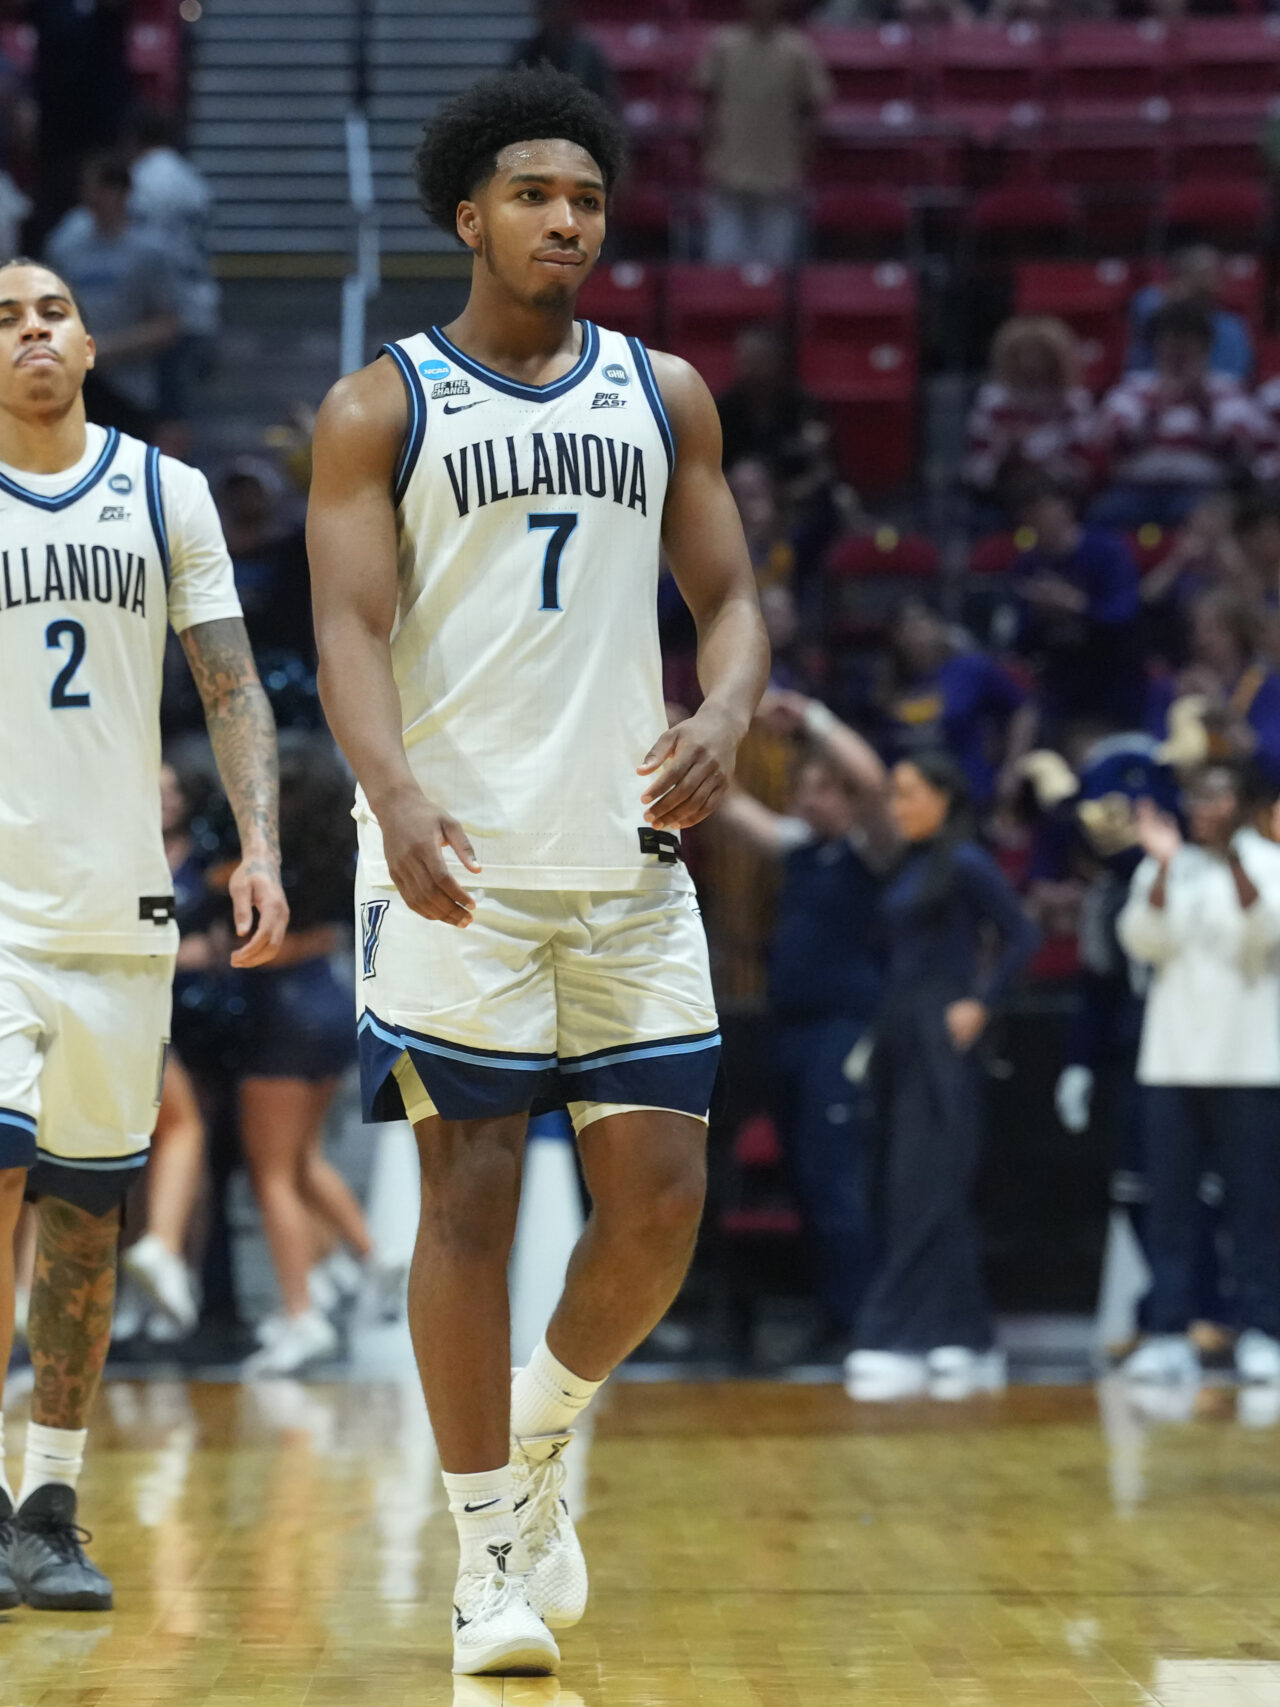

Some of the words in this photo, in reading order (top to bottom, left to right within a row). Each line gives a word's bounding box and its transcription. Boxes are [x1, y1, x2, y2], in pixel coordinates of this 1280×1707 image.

[423, 367, 449, 376] NCAA
[606, 369, 626, 380] GHR
[449, 380, 468, 388] THE
[431, 386, 470, 399] CHANGE
[594, 392, 619, 400] BIG
[443, 432, 647, 518] VILLANOVA
[527, 511, 579, 612] 7
[45, 618, 91, 710] 2
